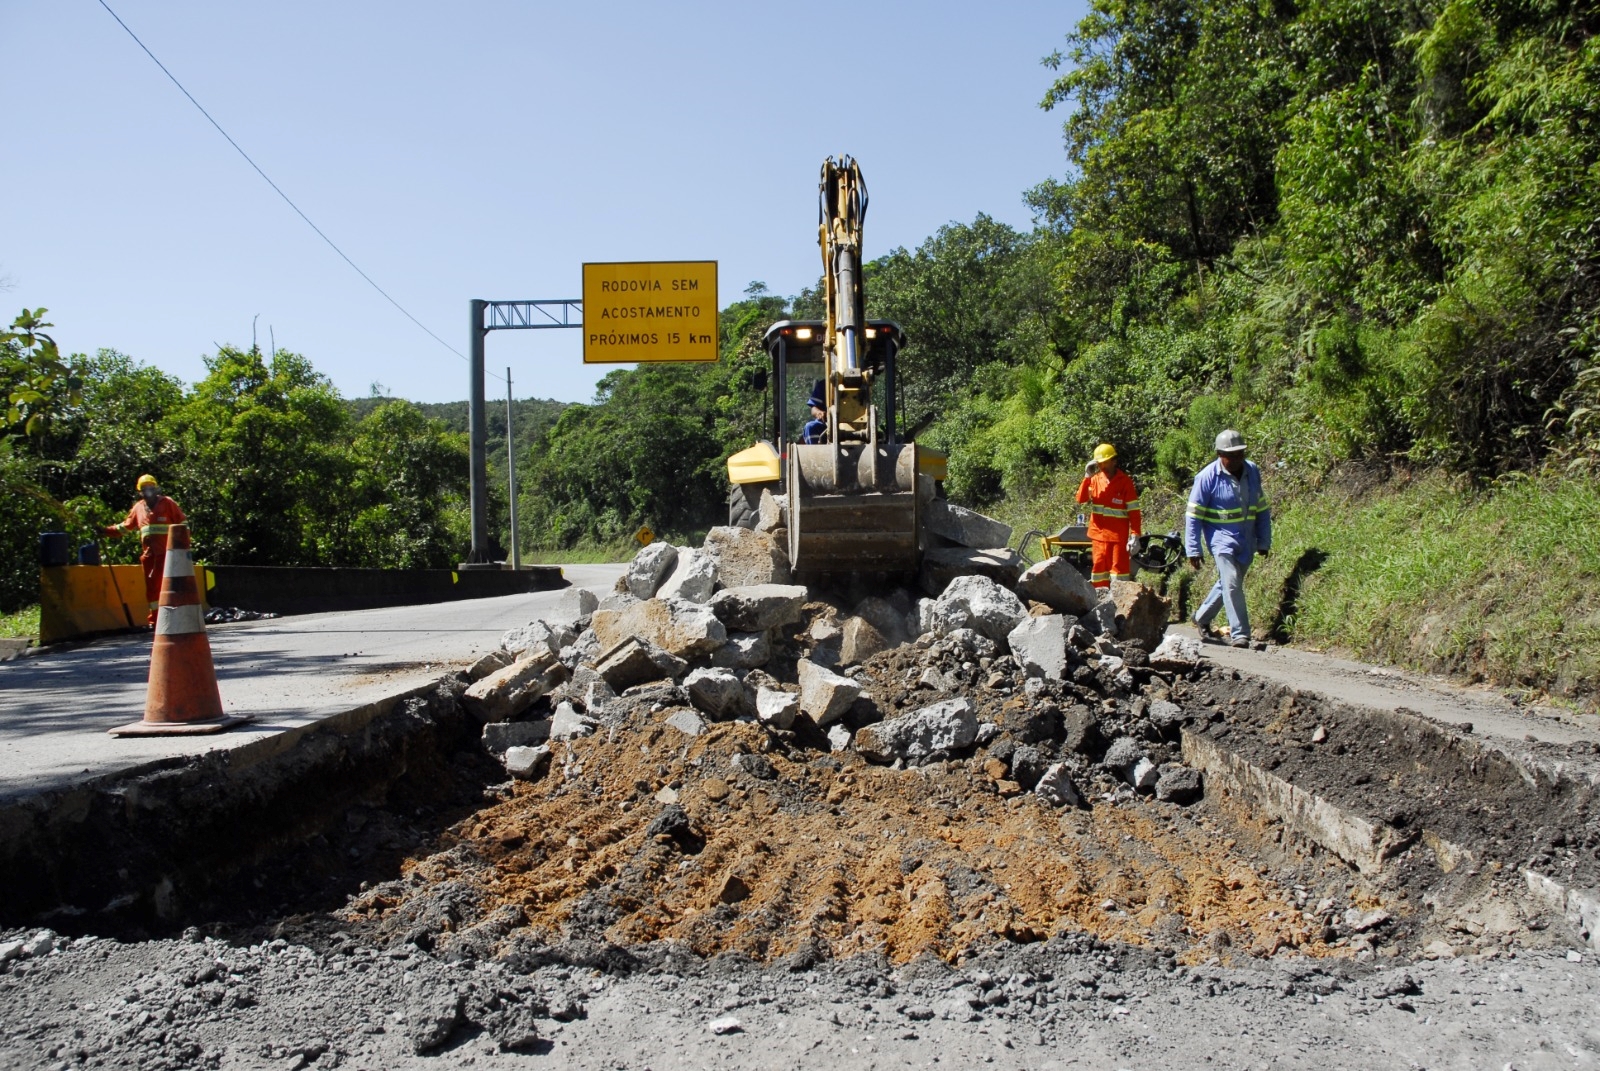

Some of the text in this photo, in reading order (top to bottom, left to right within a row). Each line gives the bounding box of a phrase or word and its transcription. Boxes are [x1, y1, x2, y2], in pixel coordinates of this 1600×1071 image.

[601, 279, 699, 292] RODOVIA SEM
[601, 306, 700, 319] ACOSTAMENTO
[589, 329, 712, 346] PRÓXIMOS 15 km
